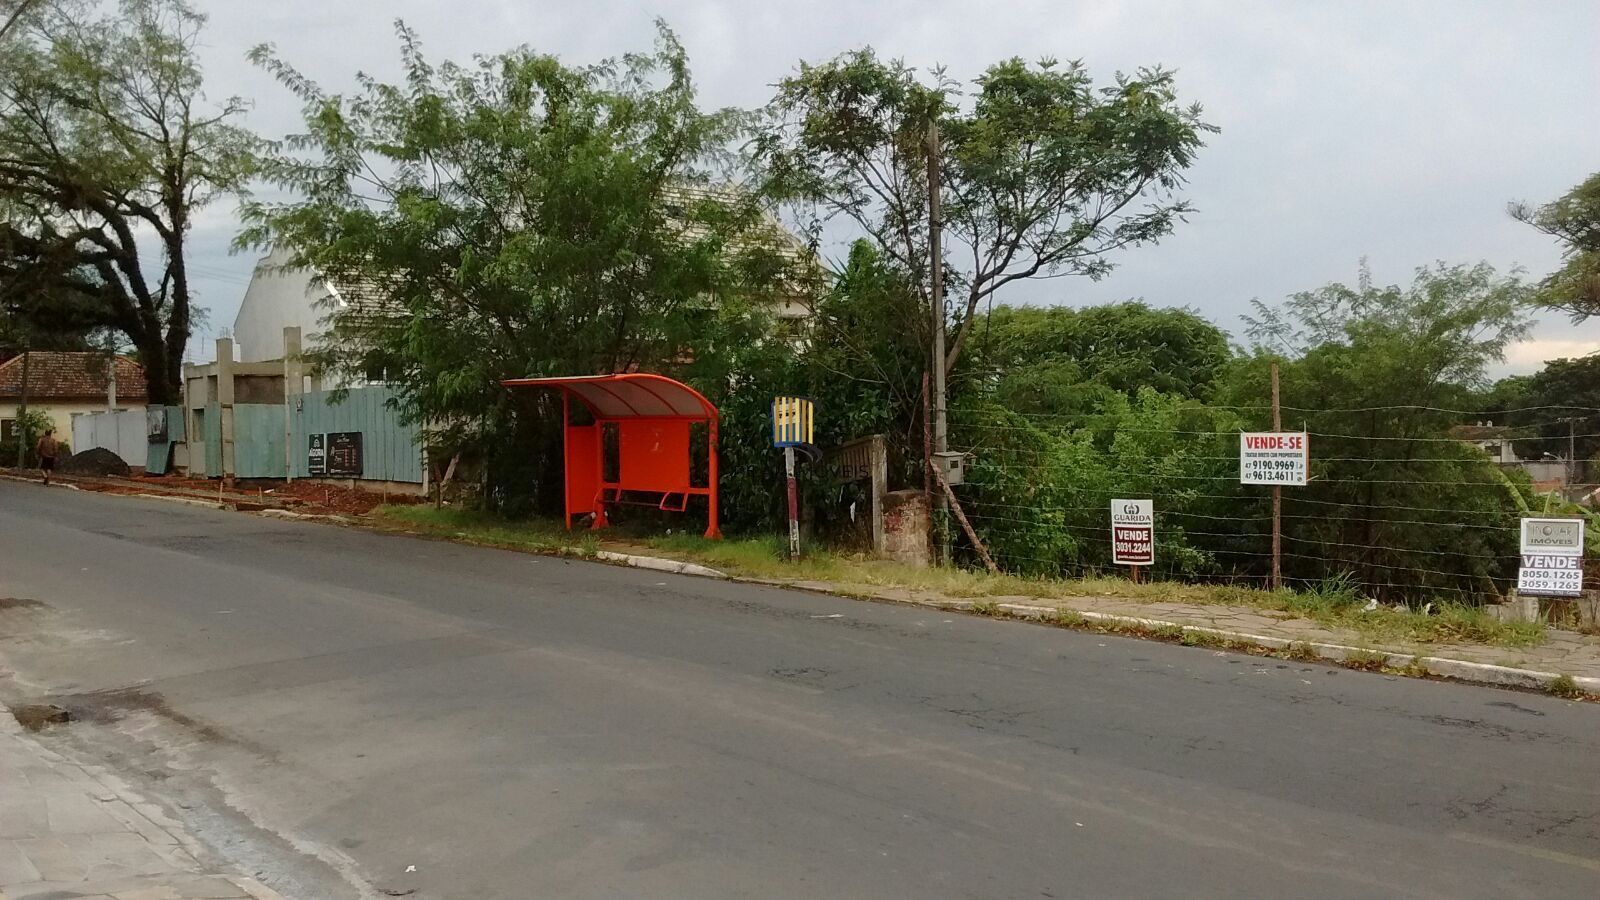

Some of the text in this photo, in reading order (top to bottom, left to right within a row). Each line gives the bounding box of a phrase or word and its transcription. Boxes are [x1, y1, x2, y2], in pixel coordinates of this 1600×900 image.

[1246, 436, 1302, 449] VENDE-SE
[1253, 460, 1295, 470] 9190.9969
[1253, 471, 1294, 481] 9613.4611
[1114, 514, 1151, 522] GUARIDA
[1117, 529, 1149, 541] VENDE
[1530, 537, 1573, 545] IMÓVEIS
[1116, 541, 1151, 553] 3031.2244
[1523, 555, 1578, 569] VENDE
[1522, 570, 1580, 580] 8050.1265
[1521, 580, 1579, 590] 3059.1265
